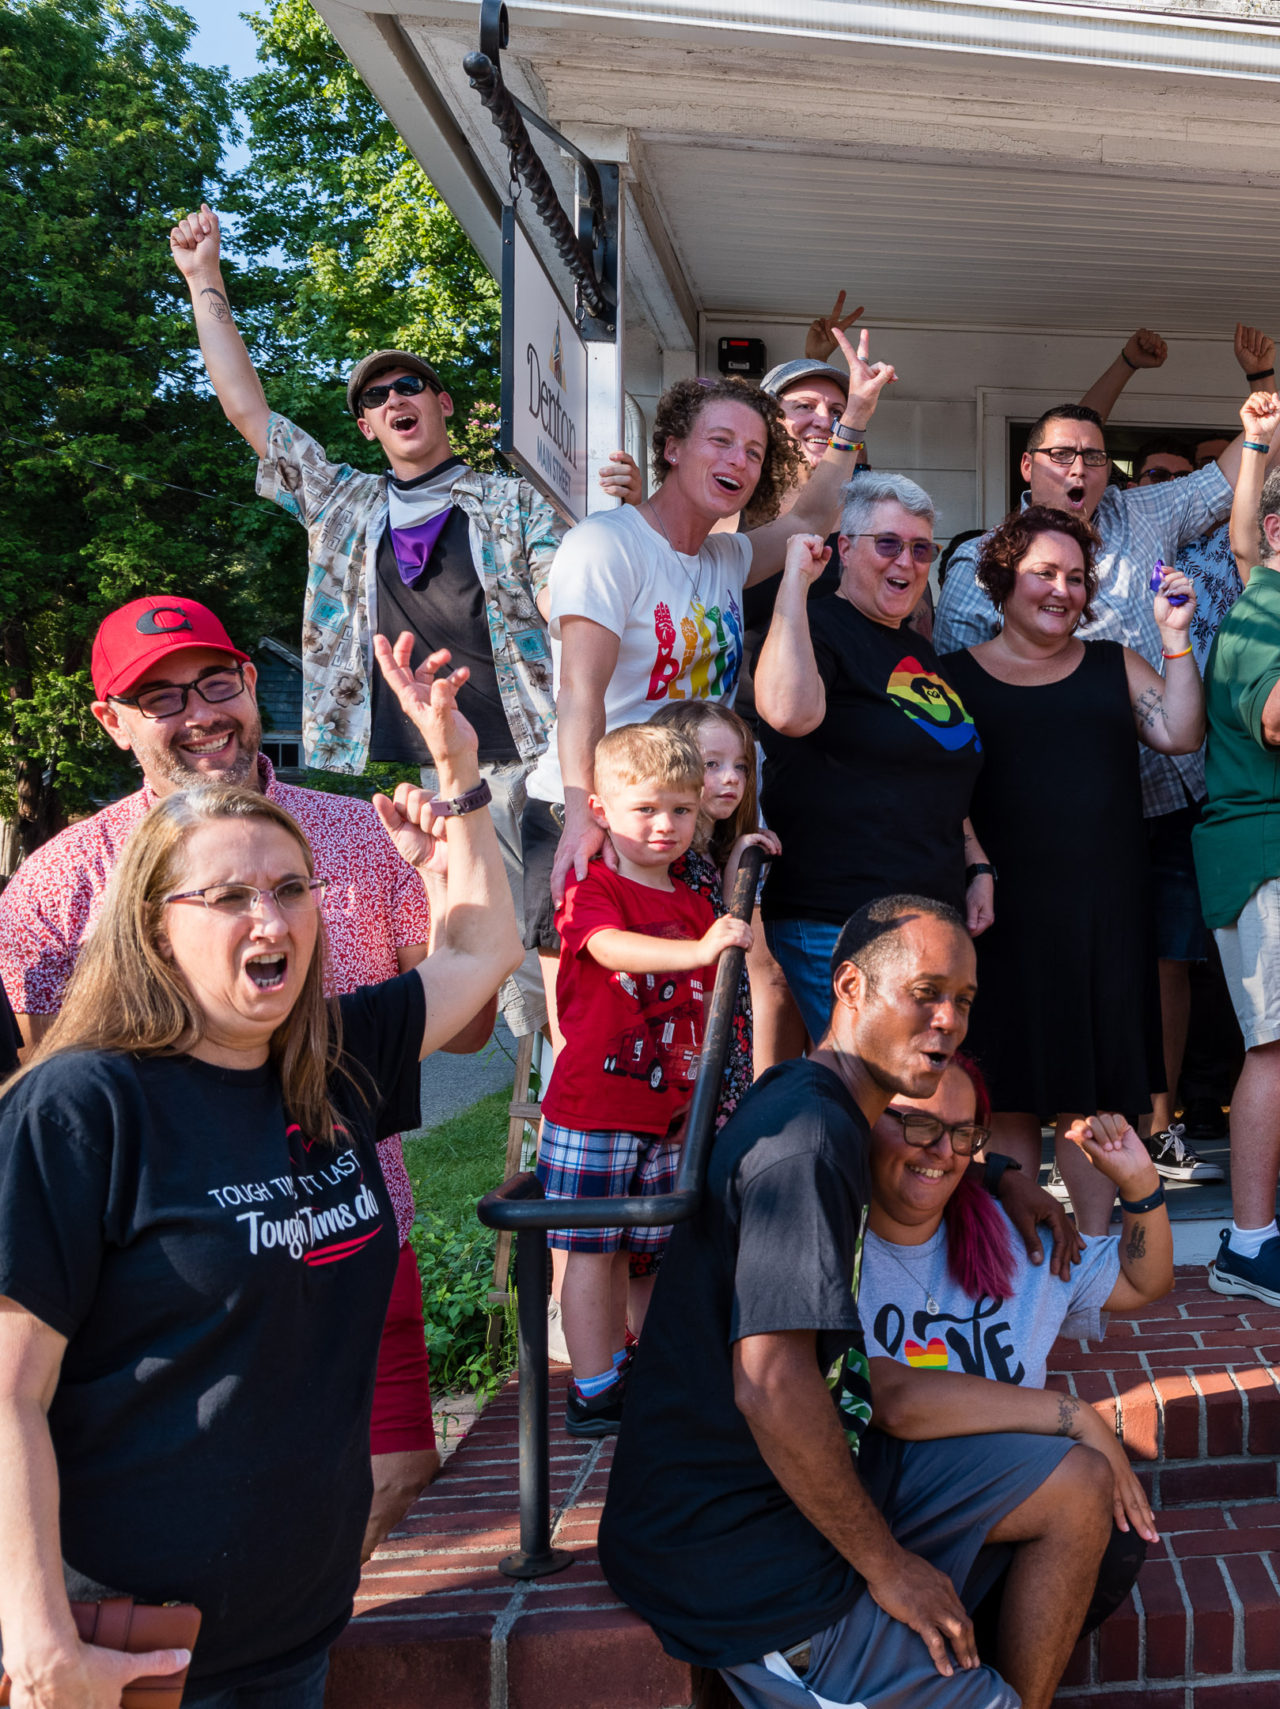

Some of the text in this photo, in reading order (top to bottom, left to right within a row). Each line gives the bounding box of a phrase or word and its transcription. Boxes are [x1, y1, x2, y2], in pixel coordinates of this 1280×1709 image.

[527, 342, 577, 470] Denton
[537, 435, 571, 499] MAIN STREET
[207, 1182, 275, 1209] TOUGH
[320, 1149, 360, 1185] LAST
[235, 1210, 308, 1260] Tough
[354, 1184, 380, 1221] do
